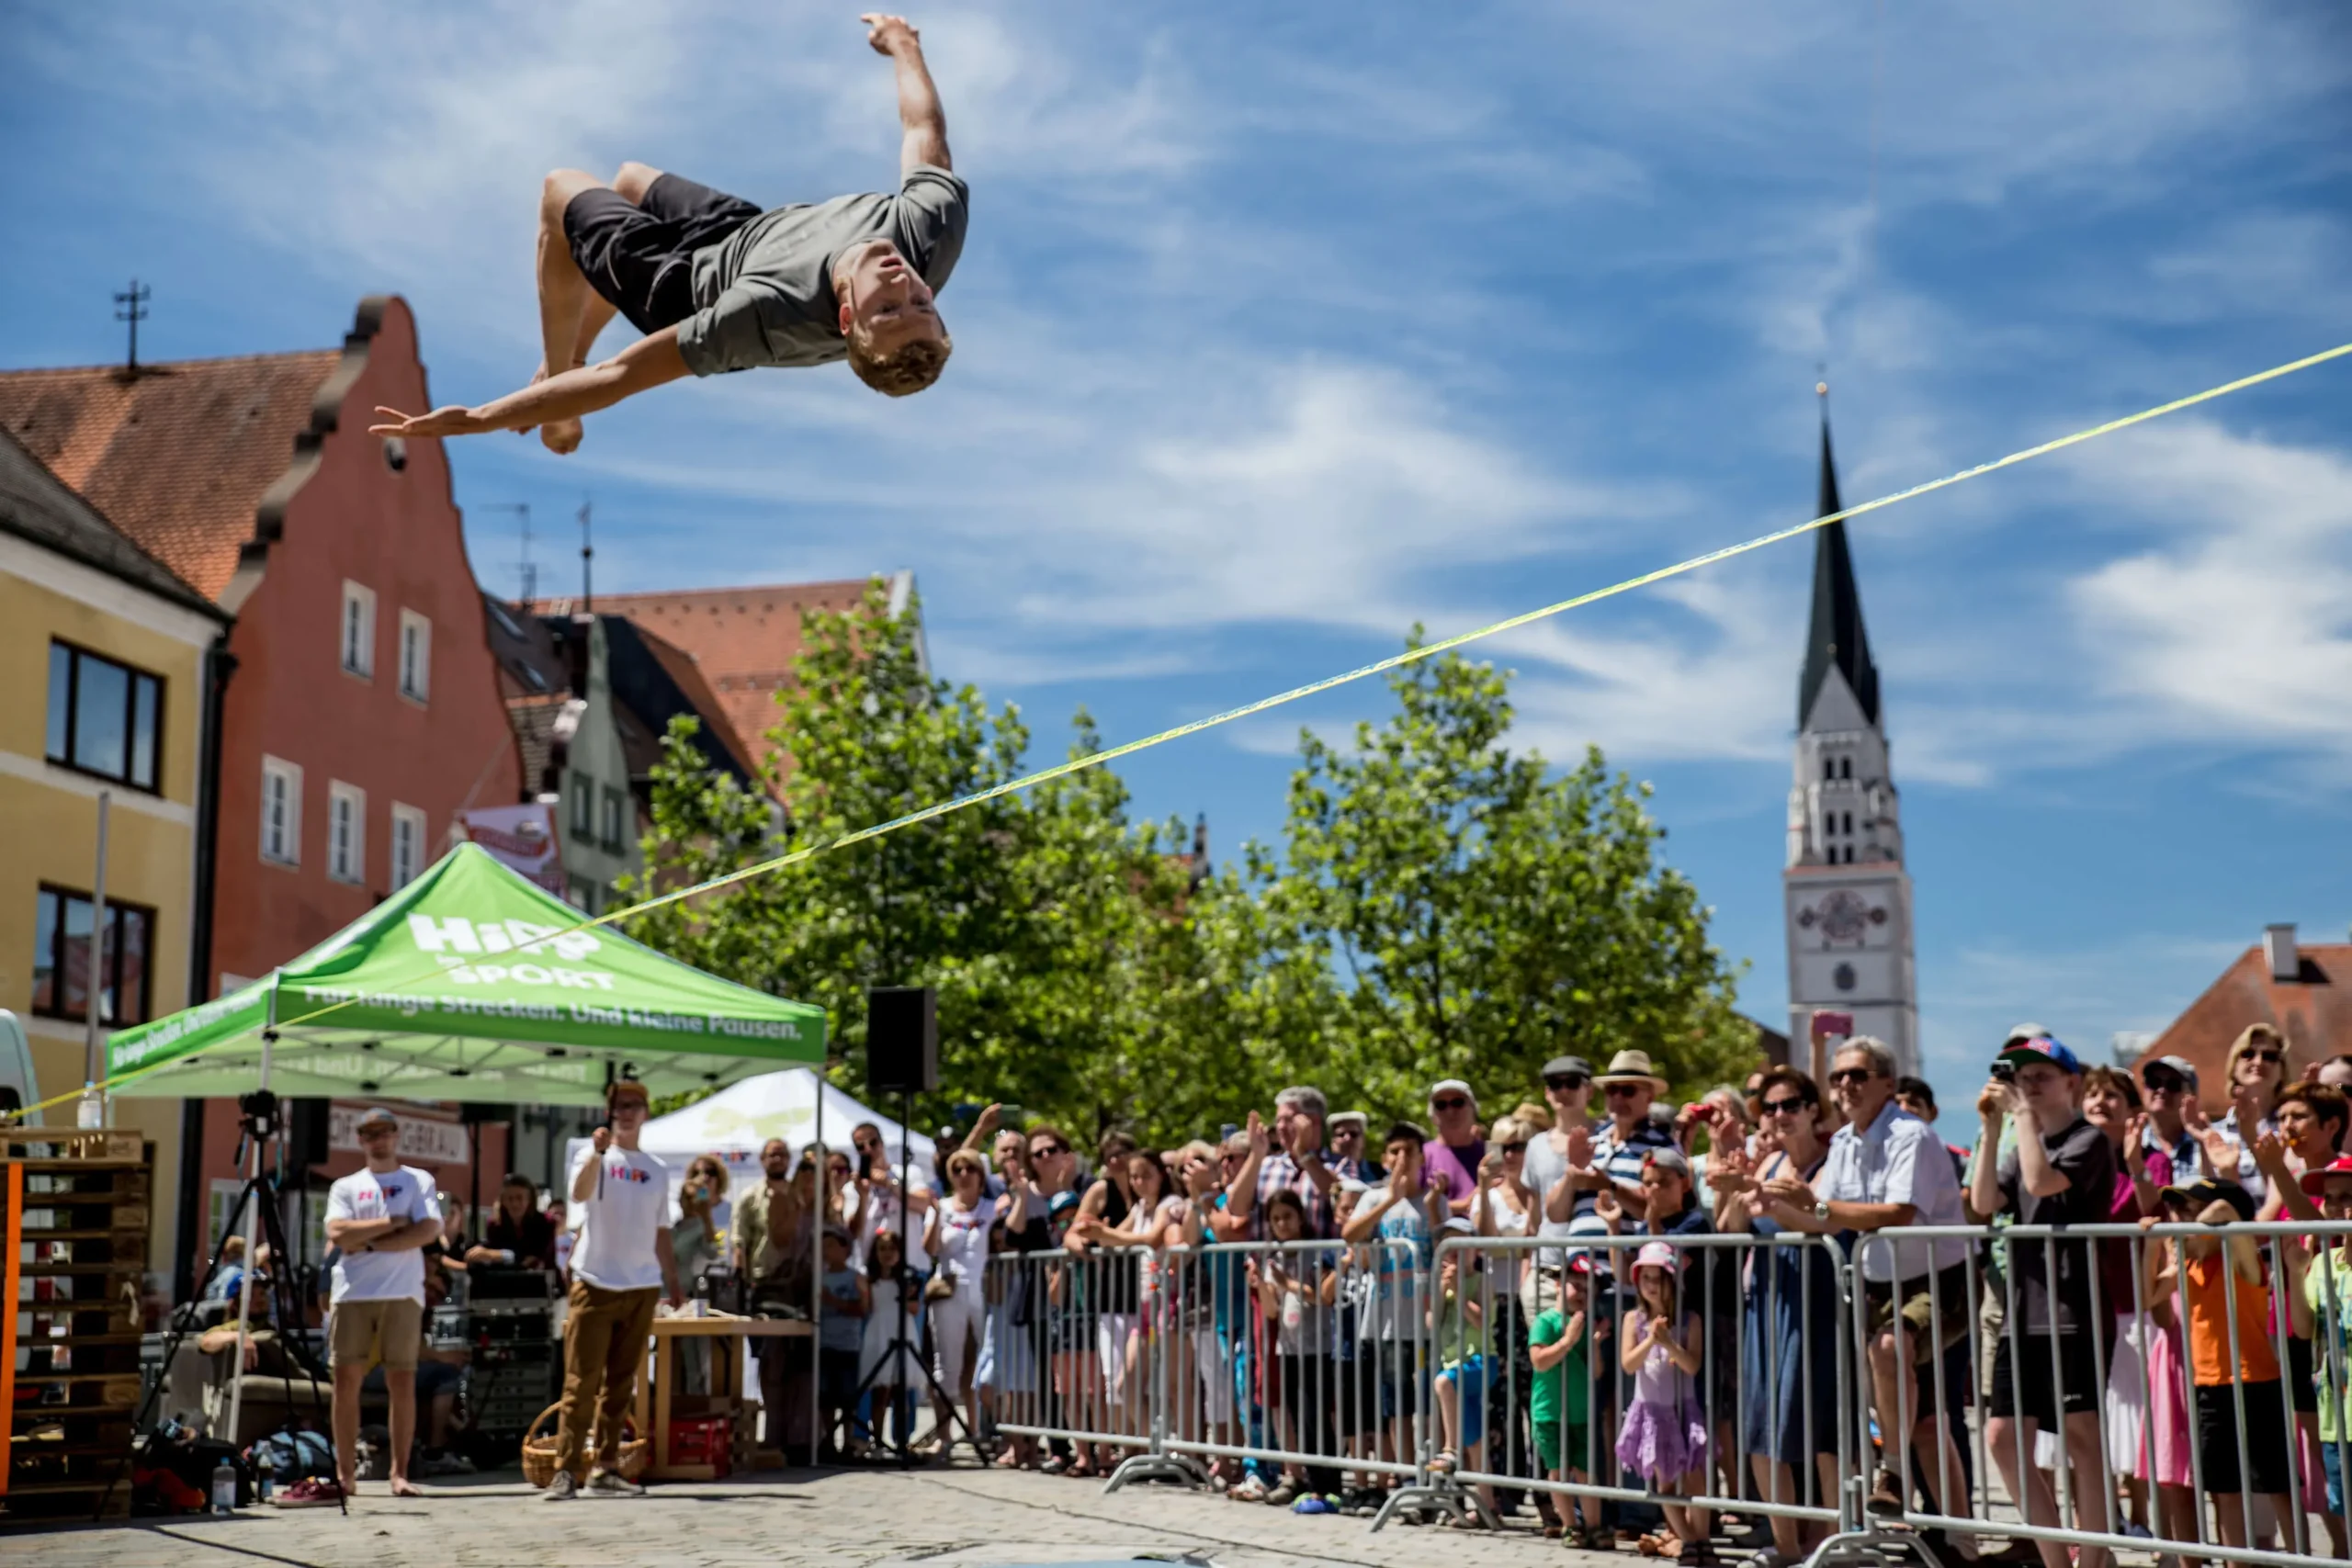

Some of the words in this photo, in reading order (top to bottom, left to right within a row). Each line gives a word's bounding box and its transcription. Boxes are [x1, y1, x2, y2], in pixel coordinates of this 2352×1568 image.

[570, 1002, 624, 1026] Und
[628, 1009, 704, 1032] kleine
[708, 1014, 803, 1040] Pausen.
